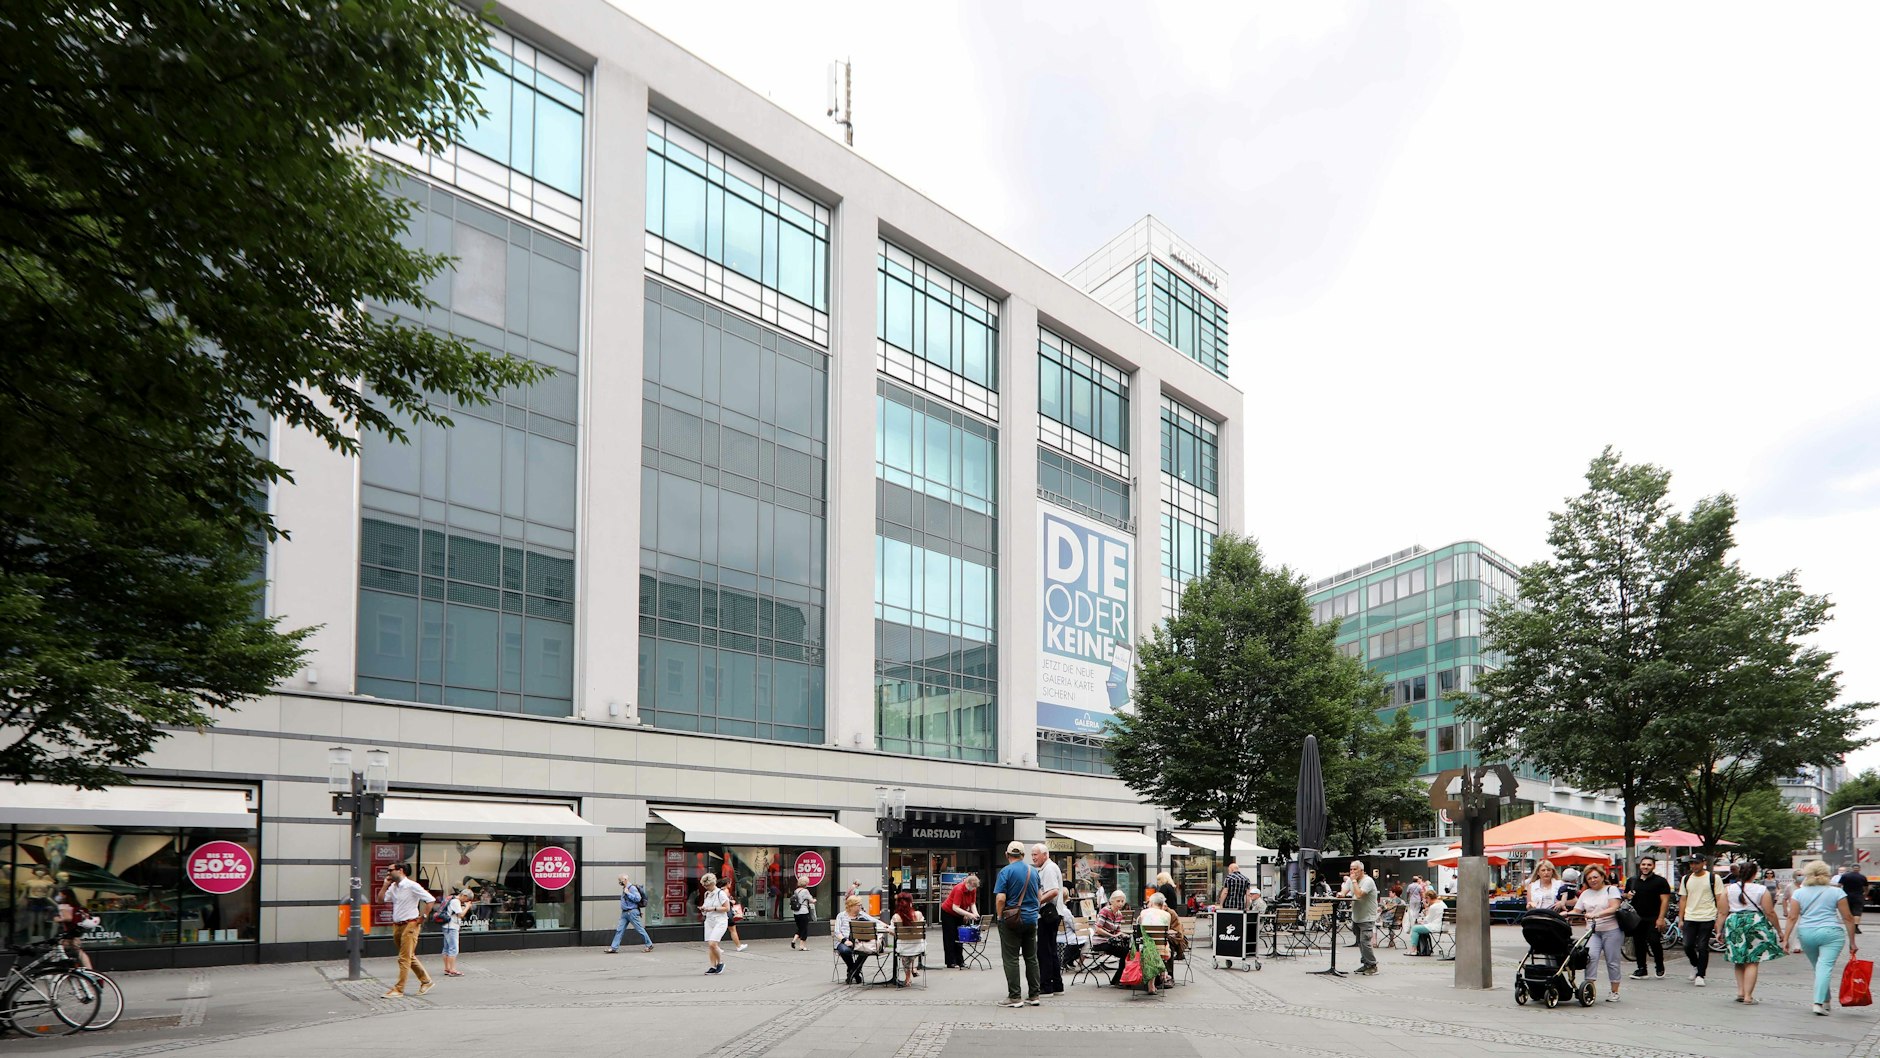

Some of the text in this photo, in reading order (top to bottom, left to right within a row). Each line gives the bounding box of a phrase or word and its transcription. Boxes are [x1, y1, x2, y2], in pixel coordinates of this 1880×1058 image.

[1047, 519, 1126, 602] DIE
[1045, 583, 1126, 639] ODER
[1046, 621, 1114, 662] KEINE
[1042, 659, 1095, 679] JETZT DIE NEUE
[1042, 672, 1073, 687] GALERIA
[1074, 679, 1095, 692] KARTE
[1042, 686, 1076, 701] SICHERN!
[1074, 718, 1100, 729] GALERIA
[912, 828, 962, 839] KARSTADT
[193, 859, 247, 873] 50%
[534, 861, 571, 873] 50%
[797, 863, 823, 873] 50%
[80, 931, 122, 939] ALERIA
[1218, 933, 1241, 942] Tchibo
